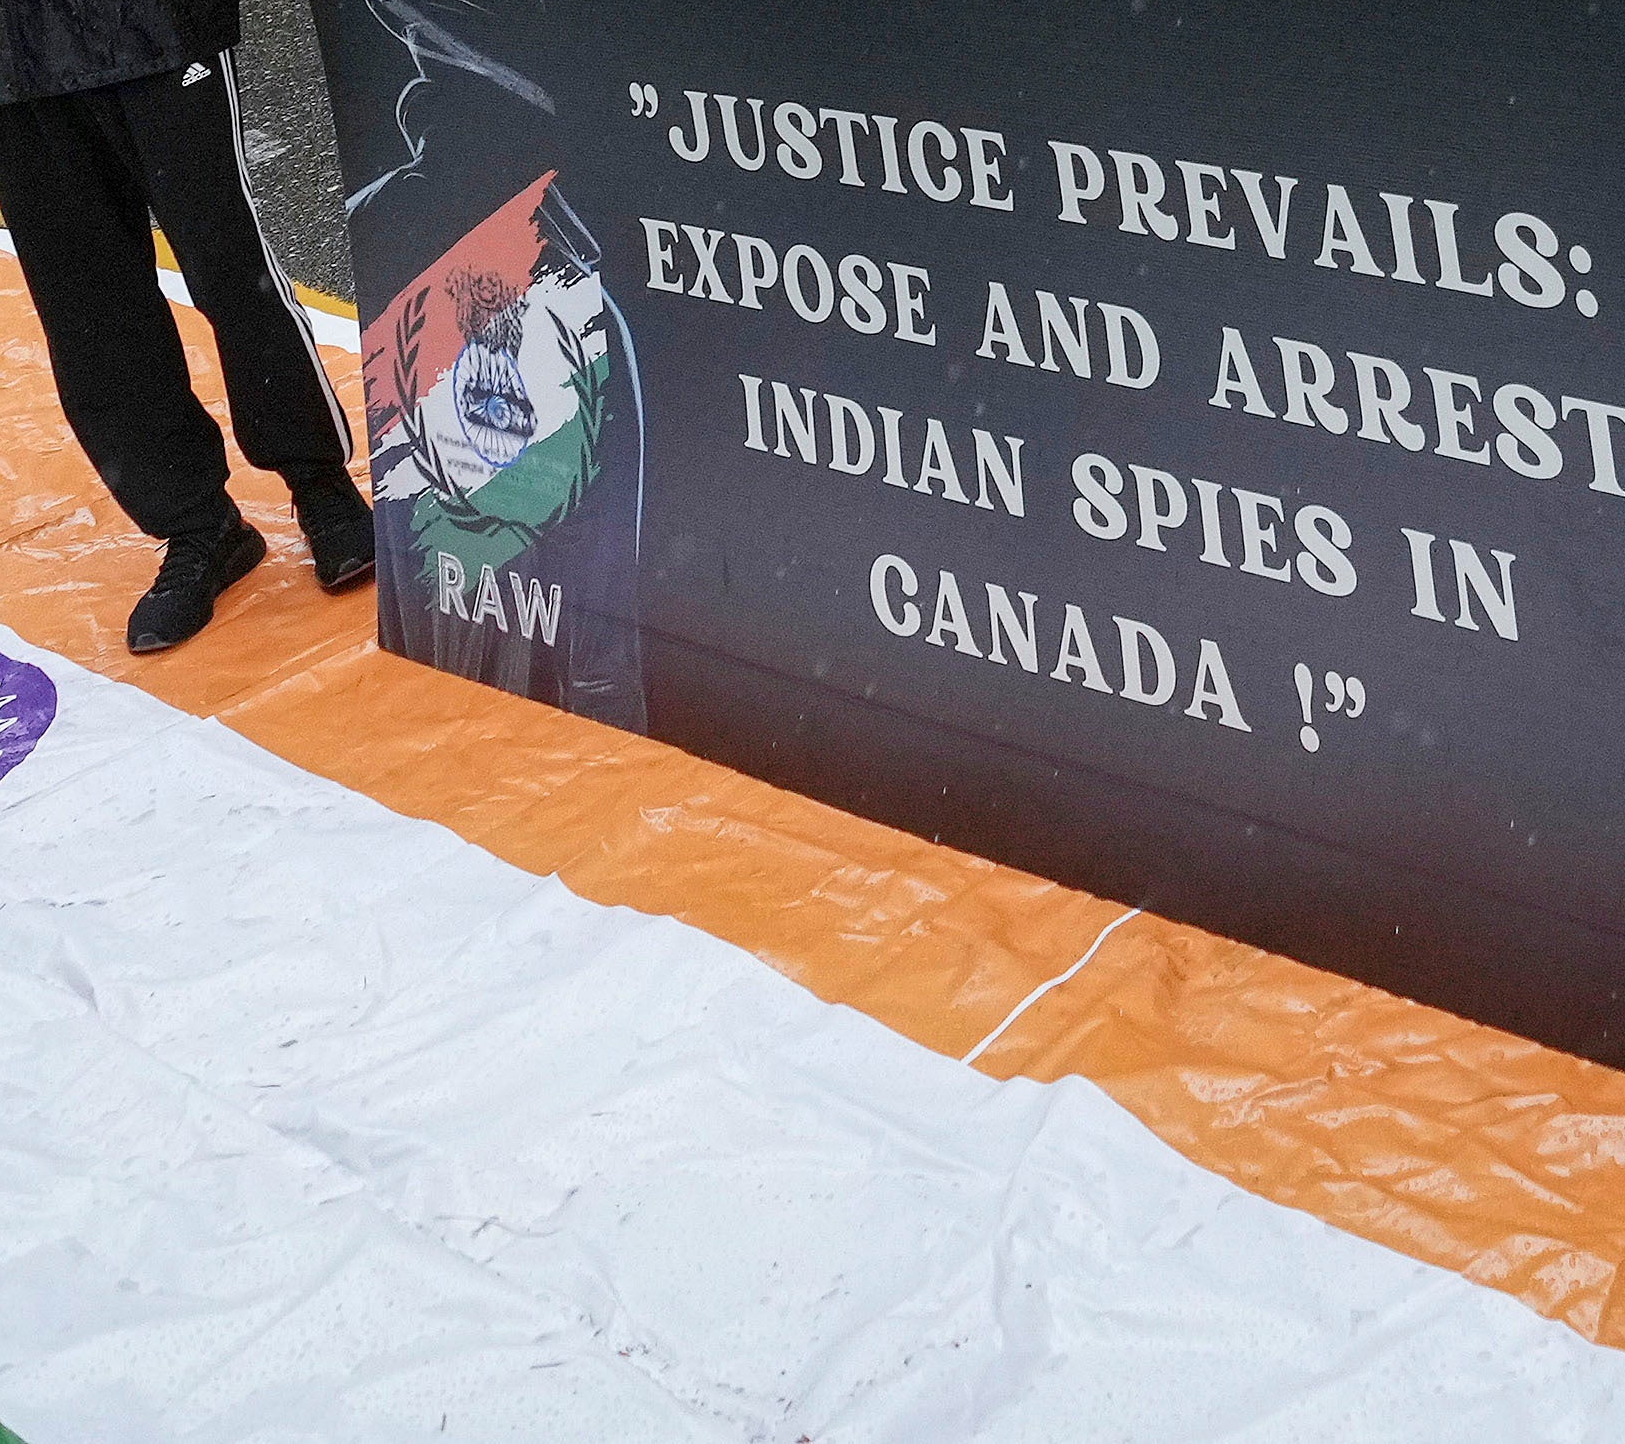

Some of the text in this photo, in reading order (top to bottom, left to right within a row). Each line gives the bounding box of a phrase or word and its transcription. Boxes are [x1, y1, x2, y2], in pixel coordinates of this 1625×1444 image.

[639, 219, 936, 347] EXPOSE
[975, 279, 1165, 391] AND
[1047, 139, 1599, 319] PREVAILS:
[742, 371, 1519, 641] INDIAN SPIES IN
[437, 551, 563, 647] RAW
[868, 551, 1254, 734] CANADA
